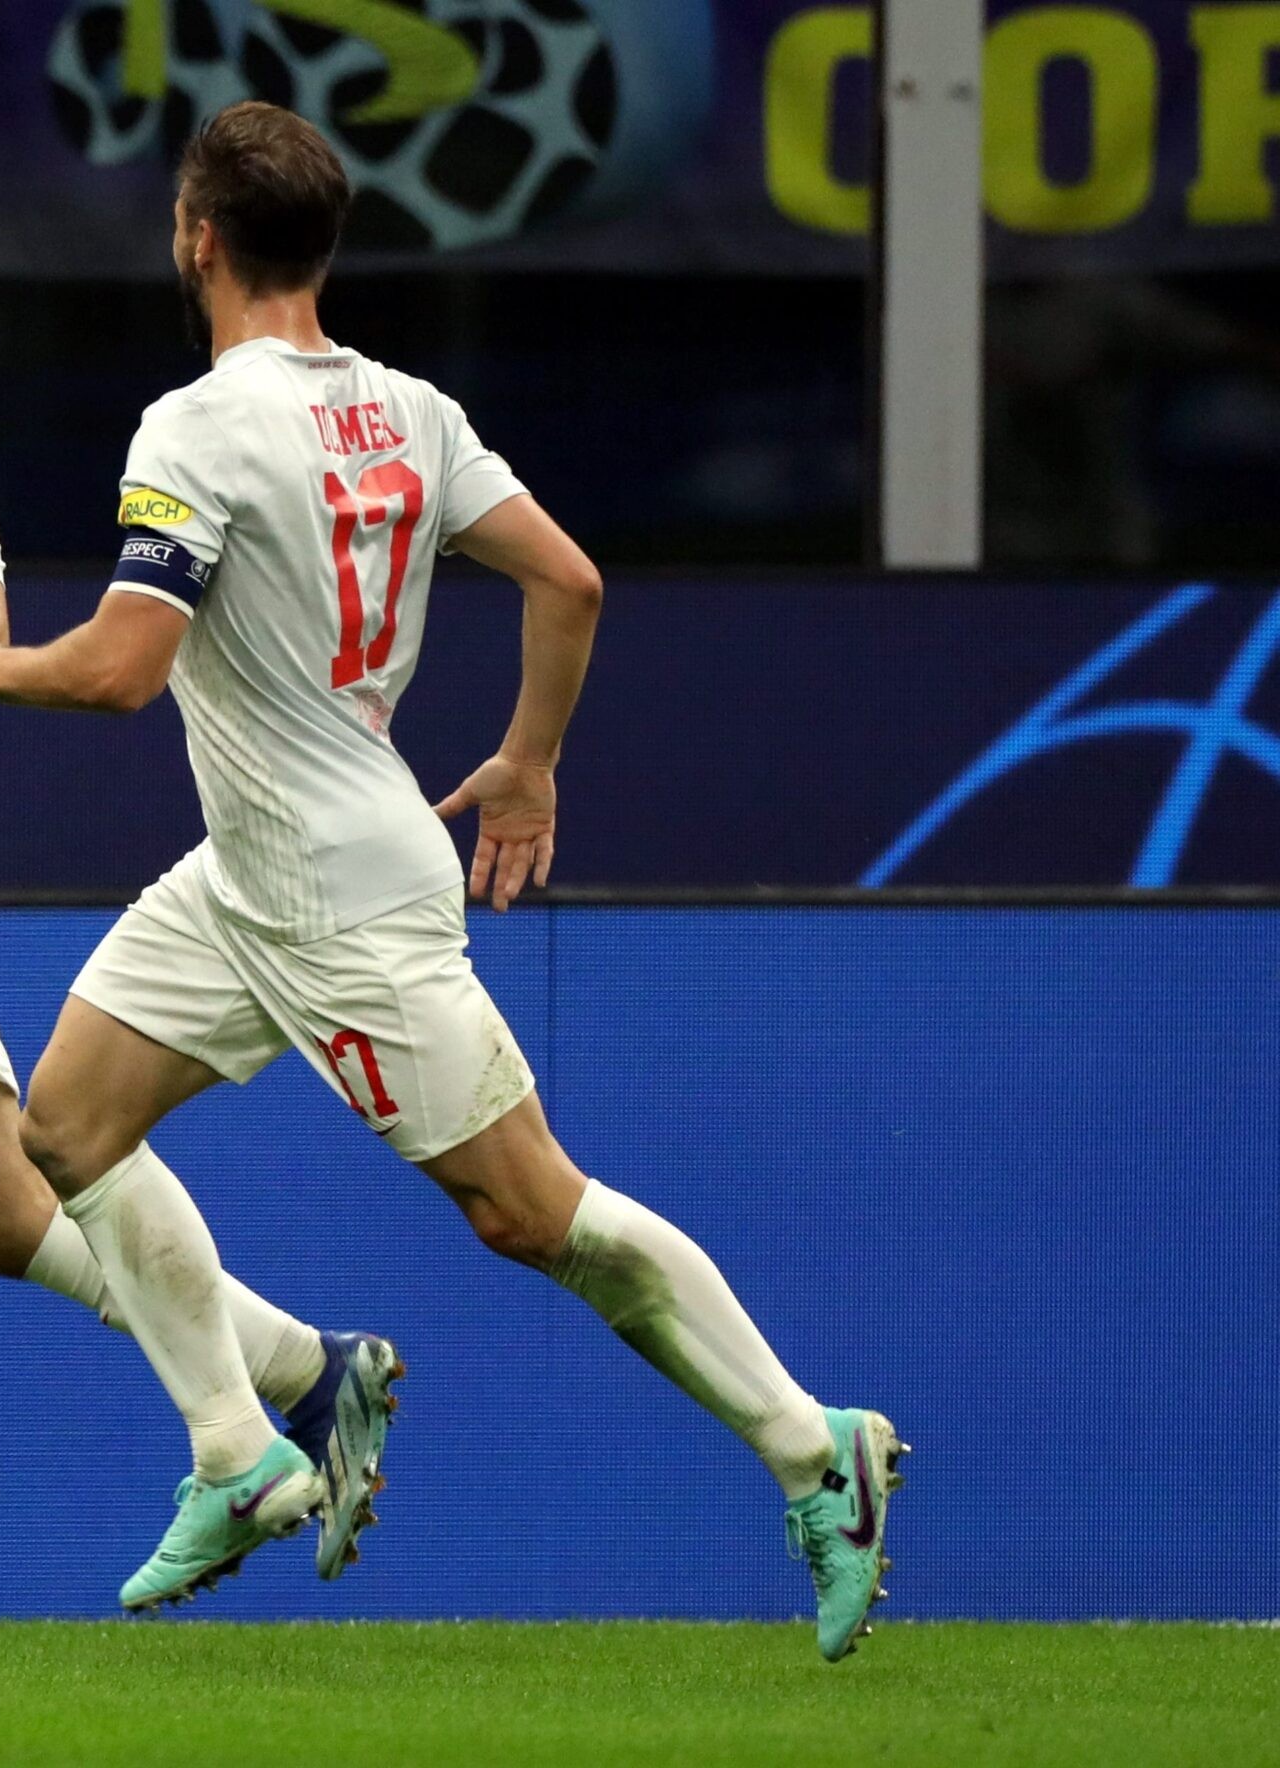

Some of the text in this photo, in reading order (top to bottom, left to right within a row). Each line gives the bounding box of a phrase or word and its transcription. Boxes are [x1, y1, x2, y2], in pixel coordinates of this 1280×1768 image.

[126, 500, 180, 520] RAUCH
[324, 459, 424, 690] 17
[314, 1028, 400, 1118] 17
